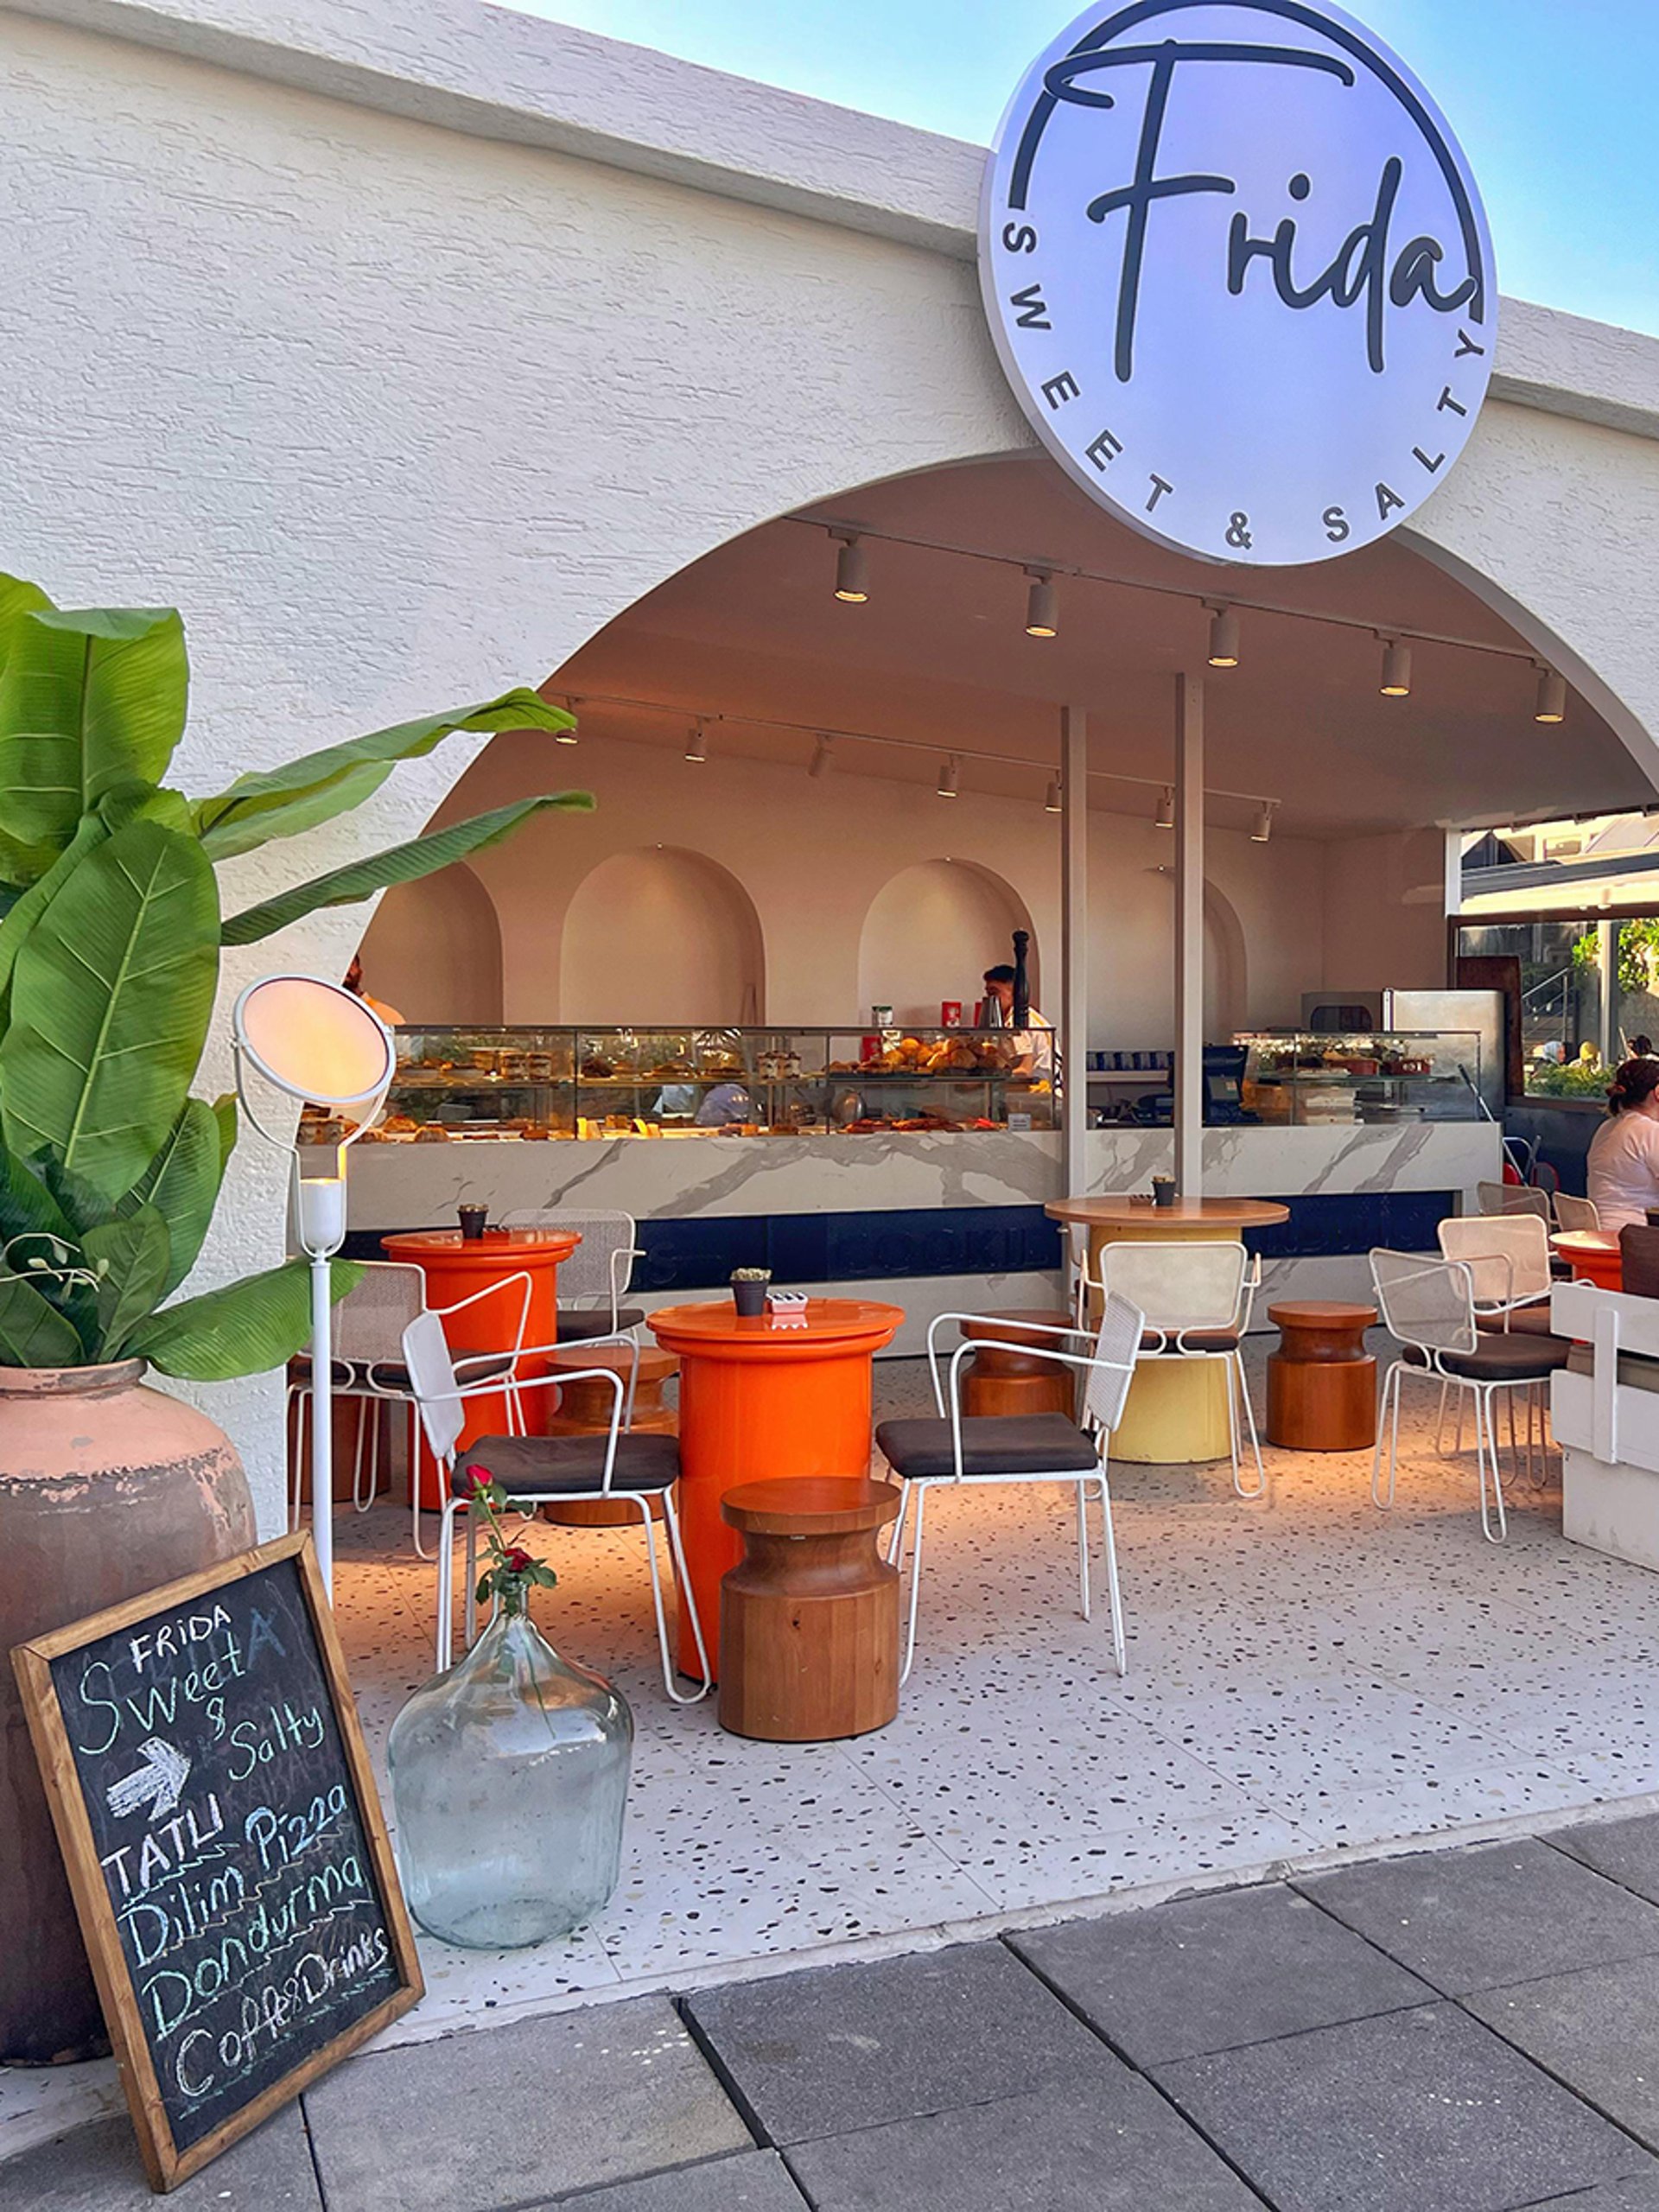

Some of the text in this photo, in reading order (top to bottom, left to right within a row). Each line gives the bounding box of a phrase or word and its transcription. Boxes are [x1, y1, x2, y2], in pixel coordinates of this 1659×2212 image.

[1045, 40, 1477, 382] Frida
[1002, 223, 1484, 550] SWEET & SALTY
[79, 1630, 245, 1754] Sweet
[228, 1703, 324, 1780] Salty
[100, 1793, 225, 1896] TATLI
[117, 1785, 346, 1968] Dilim Pizza
[142, 1857, 363, 2042] Dondurma
